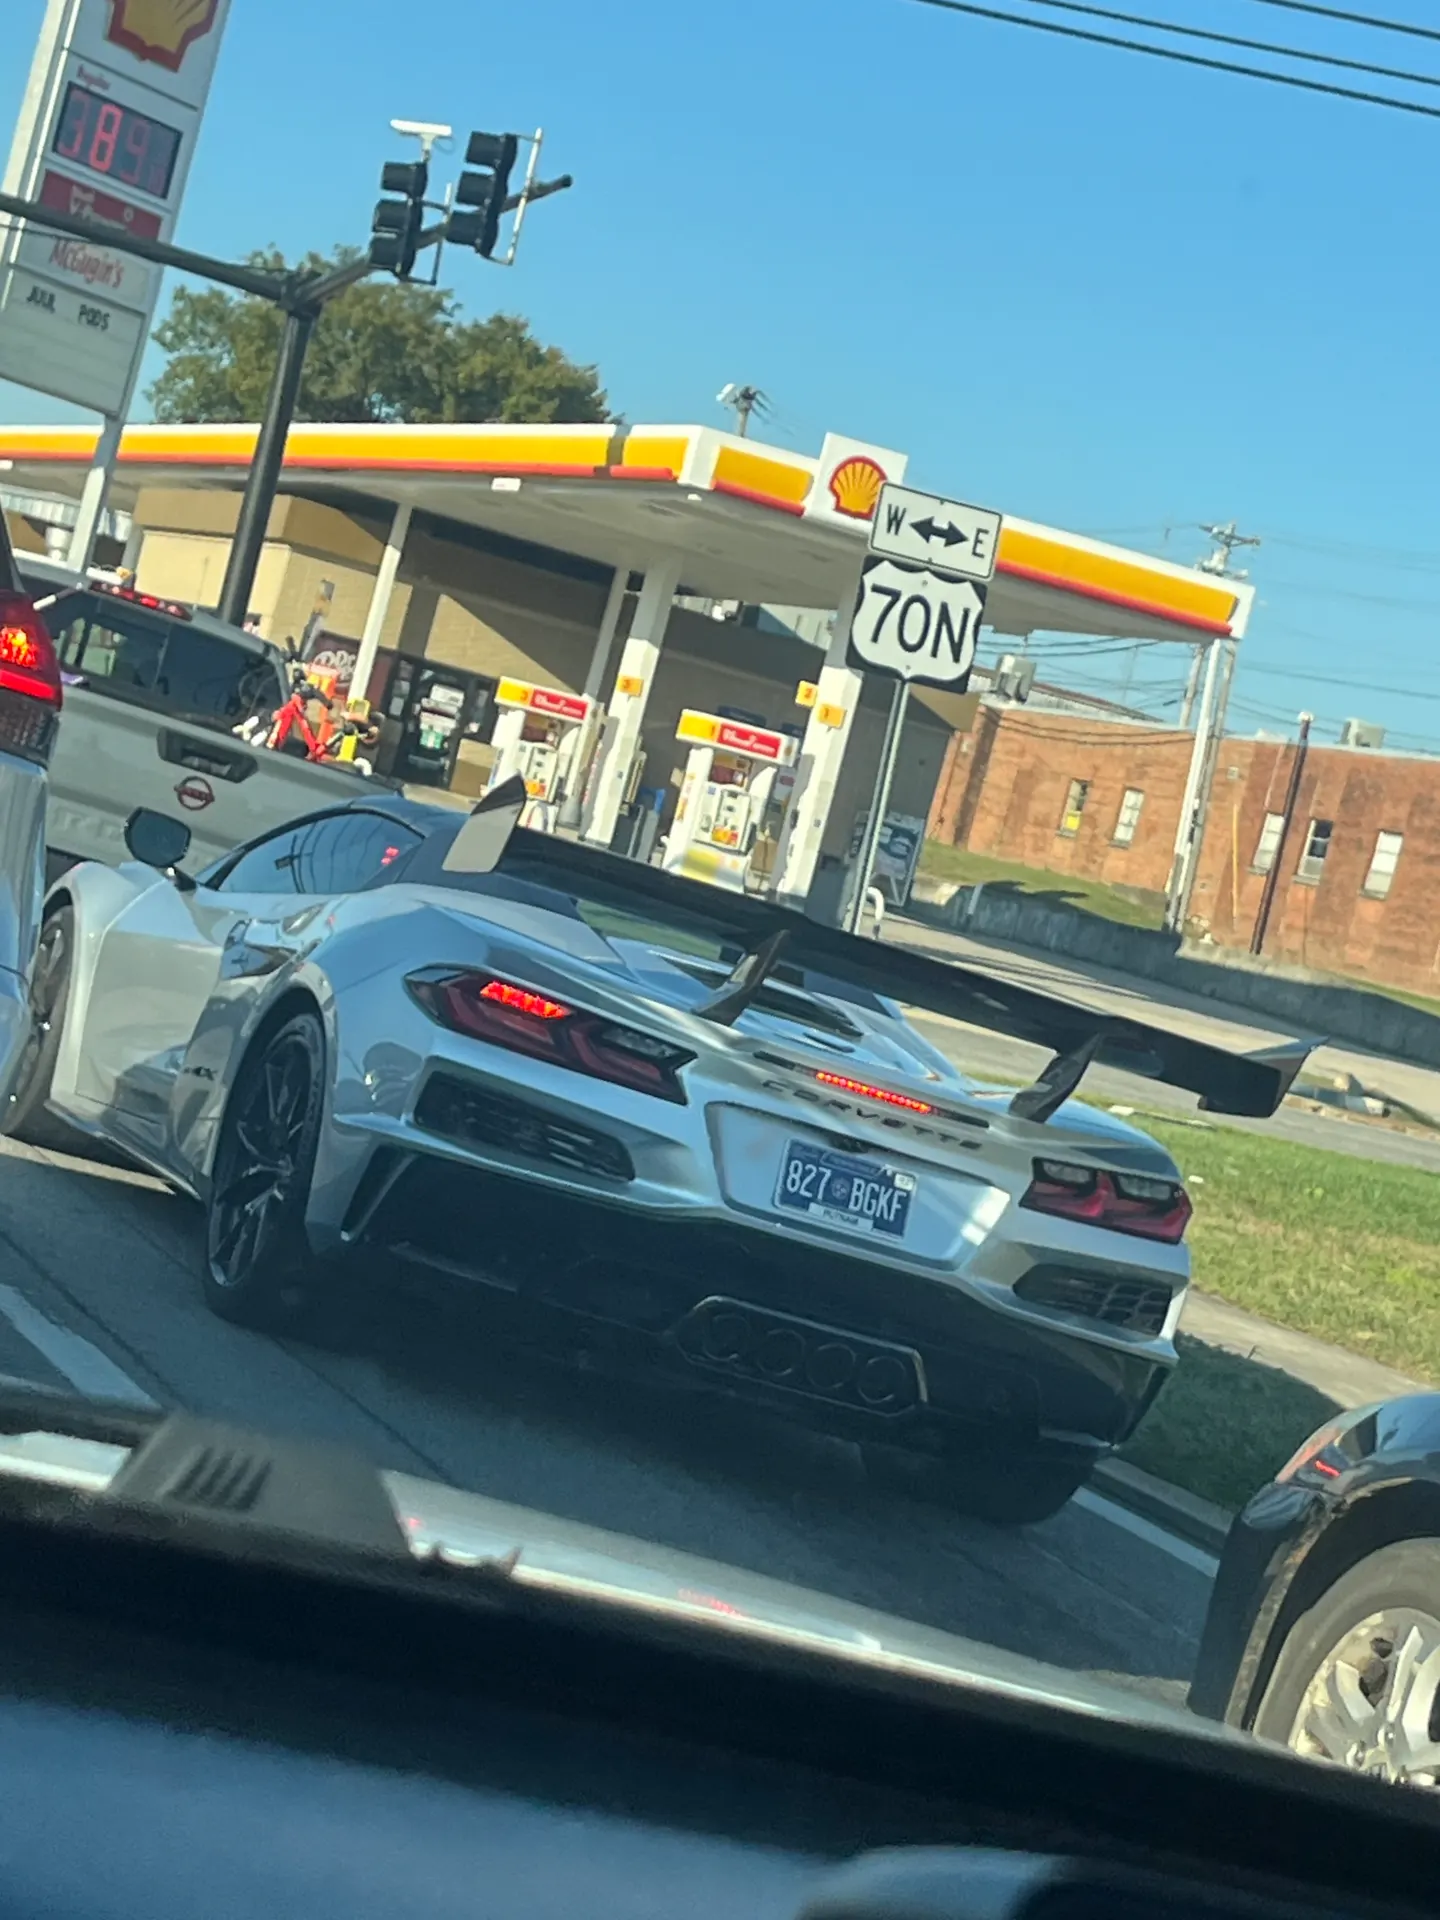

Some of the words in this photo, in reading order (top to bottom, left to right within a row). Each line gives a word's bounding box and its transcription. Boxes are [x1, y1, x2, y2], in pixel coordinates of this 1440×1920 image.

[886, 503, 907, 536] W
[971, 527, 990, 559] E
[870, 583, 970, 664] 70N
[762, 1079, 983, 1150] CORVETTE
[786, 1160, 832, 1200] 827
[848, 1177, 907, 1222] BGKF
